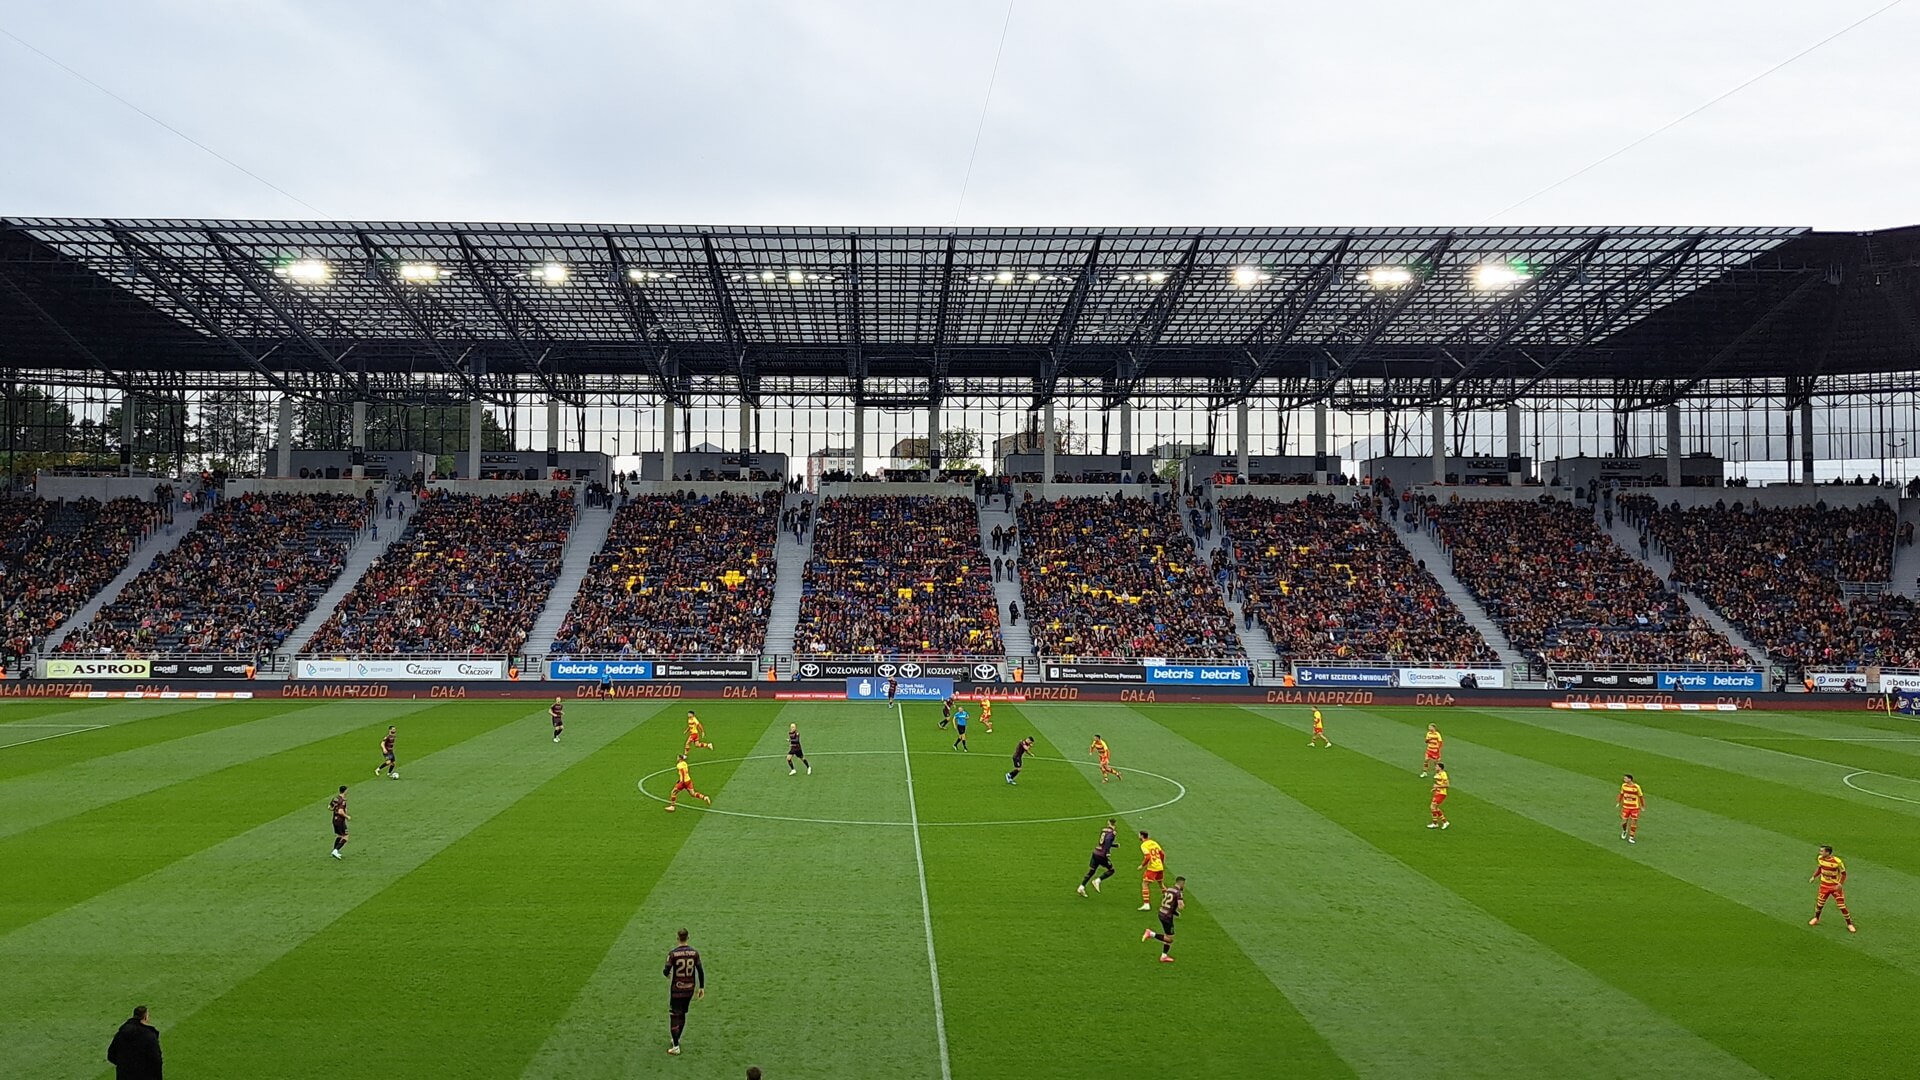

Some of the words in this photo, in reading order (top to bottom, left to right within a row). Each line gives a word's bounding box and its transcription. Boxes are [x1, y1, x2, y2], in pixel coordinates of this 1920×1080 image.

[73, 665, 146, 674] ASPROD
[154, 665, 178, 673] capelli
[189, 665, 213, 673] capelli
[558, 664, 598, 674] betcris
[605, 664, 645, 674] betcris
[825, 667, 872, 675] KOZŁOWSKI
[927, 667, 962, 675] KOZŁOWS
[1154, 669, 1194, 679] betcris
[1201, 670, 1241, 680] betcris
[1713, 676, 1755, 686] betcris
[26, 680, 92, 696] NAPRZÓD
[282, 685, 318, 697] CAŁA
[322, 682, 388, 697] NAPRZÓD
[430, 686, 466, 698] CAŁA
[616, 683, 682, 698] NAPRZÓD
[723, 686, 758, 698] CAŁA
[1013, 685, 1078, 700] NAPRZÓD
[1120, 689, 1156, 701] CAŁA
[1267, 691, 1302, 703] CAŁA
[1307, 689, 1373, 704] NAPRZÓD
[1416, 693, 1453, 706] CAŁA
[675, 958, 695, 977] 28
